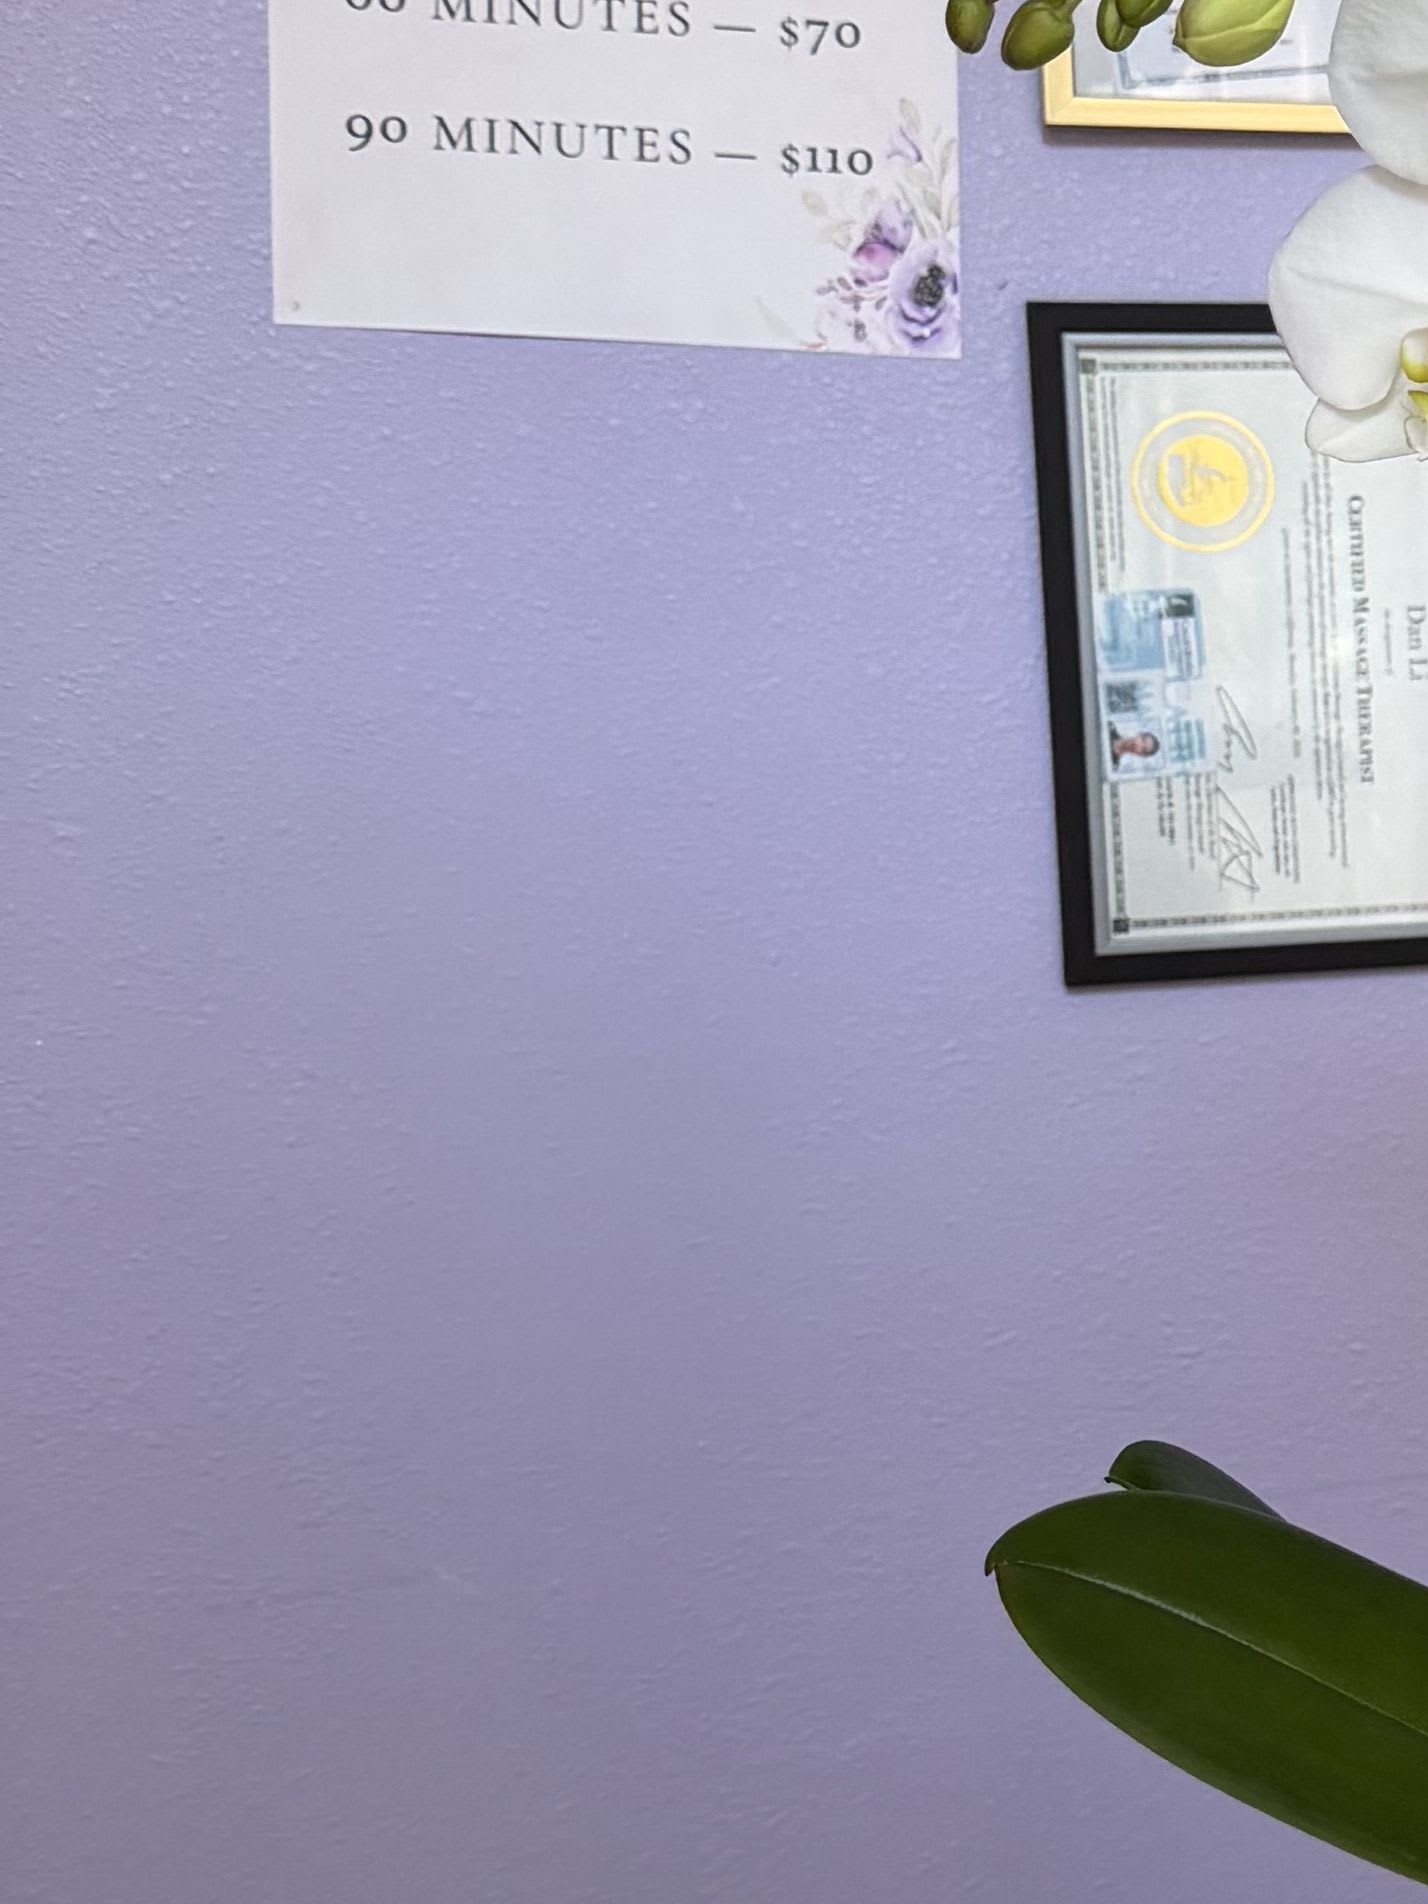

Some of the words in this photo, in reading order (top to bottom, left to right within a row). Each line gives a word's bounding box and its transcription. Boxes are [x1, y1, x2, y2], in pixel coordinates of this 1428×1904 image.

[779, 16, 861, 56] $70
[345, 113, 408, 152] 90
[433, 115, 692, 165] MINUTES
[780, 143, 873, 177] $110
[1346, 494, 1366, 591] CERTIFIED
[1353, 597, 1370, 678] MASSAGE
[1406, 605, 1426, 650] Dan
[1408, 658, 1428, 681] Li
[1356, 685, 1375, 784] THERAPIST
